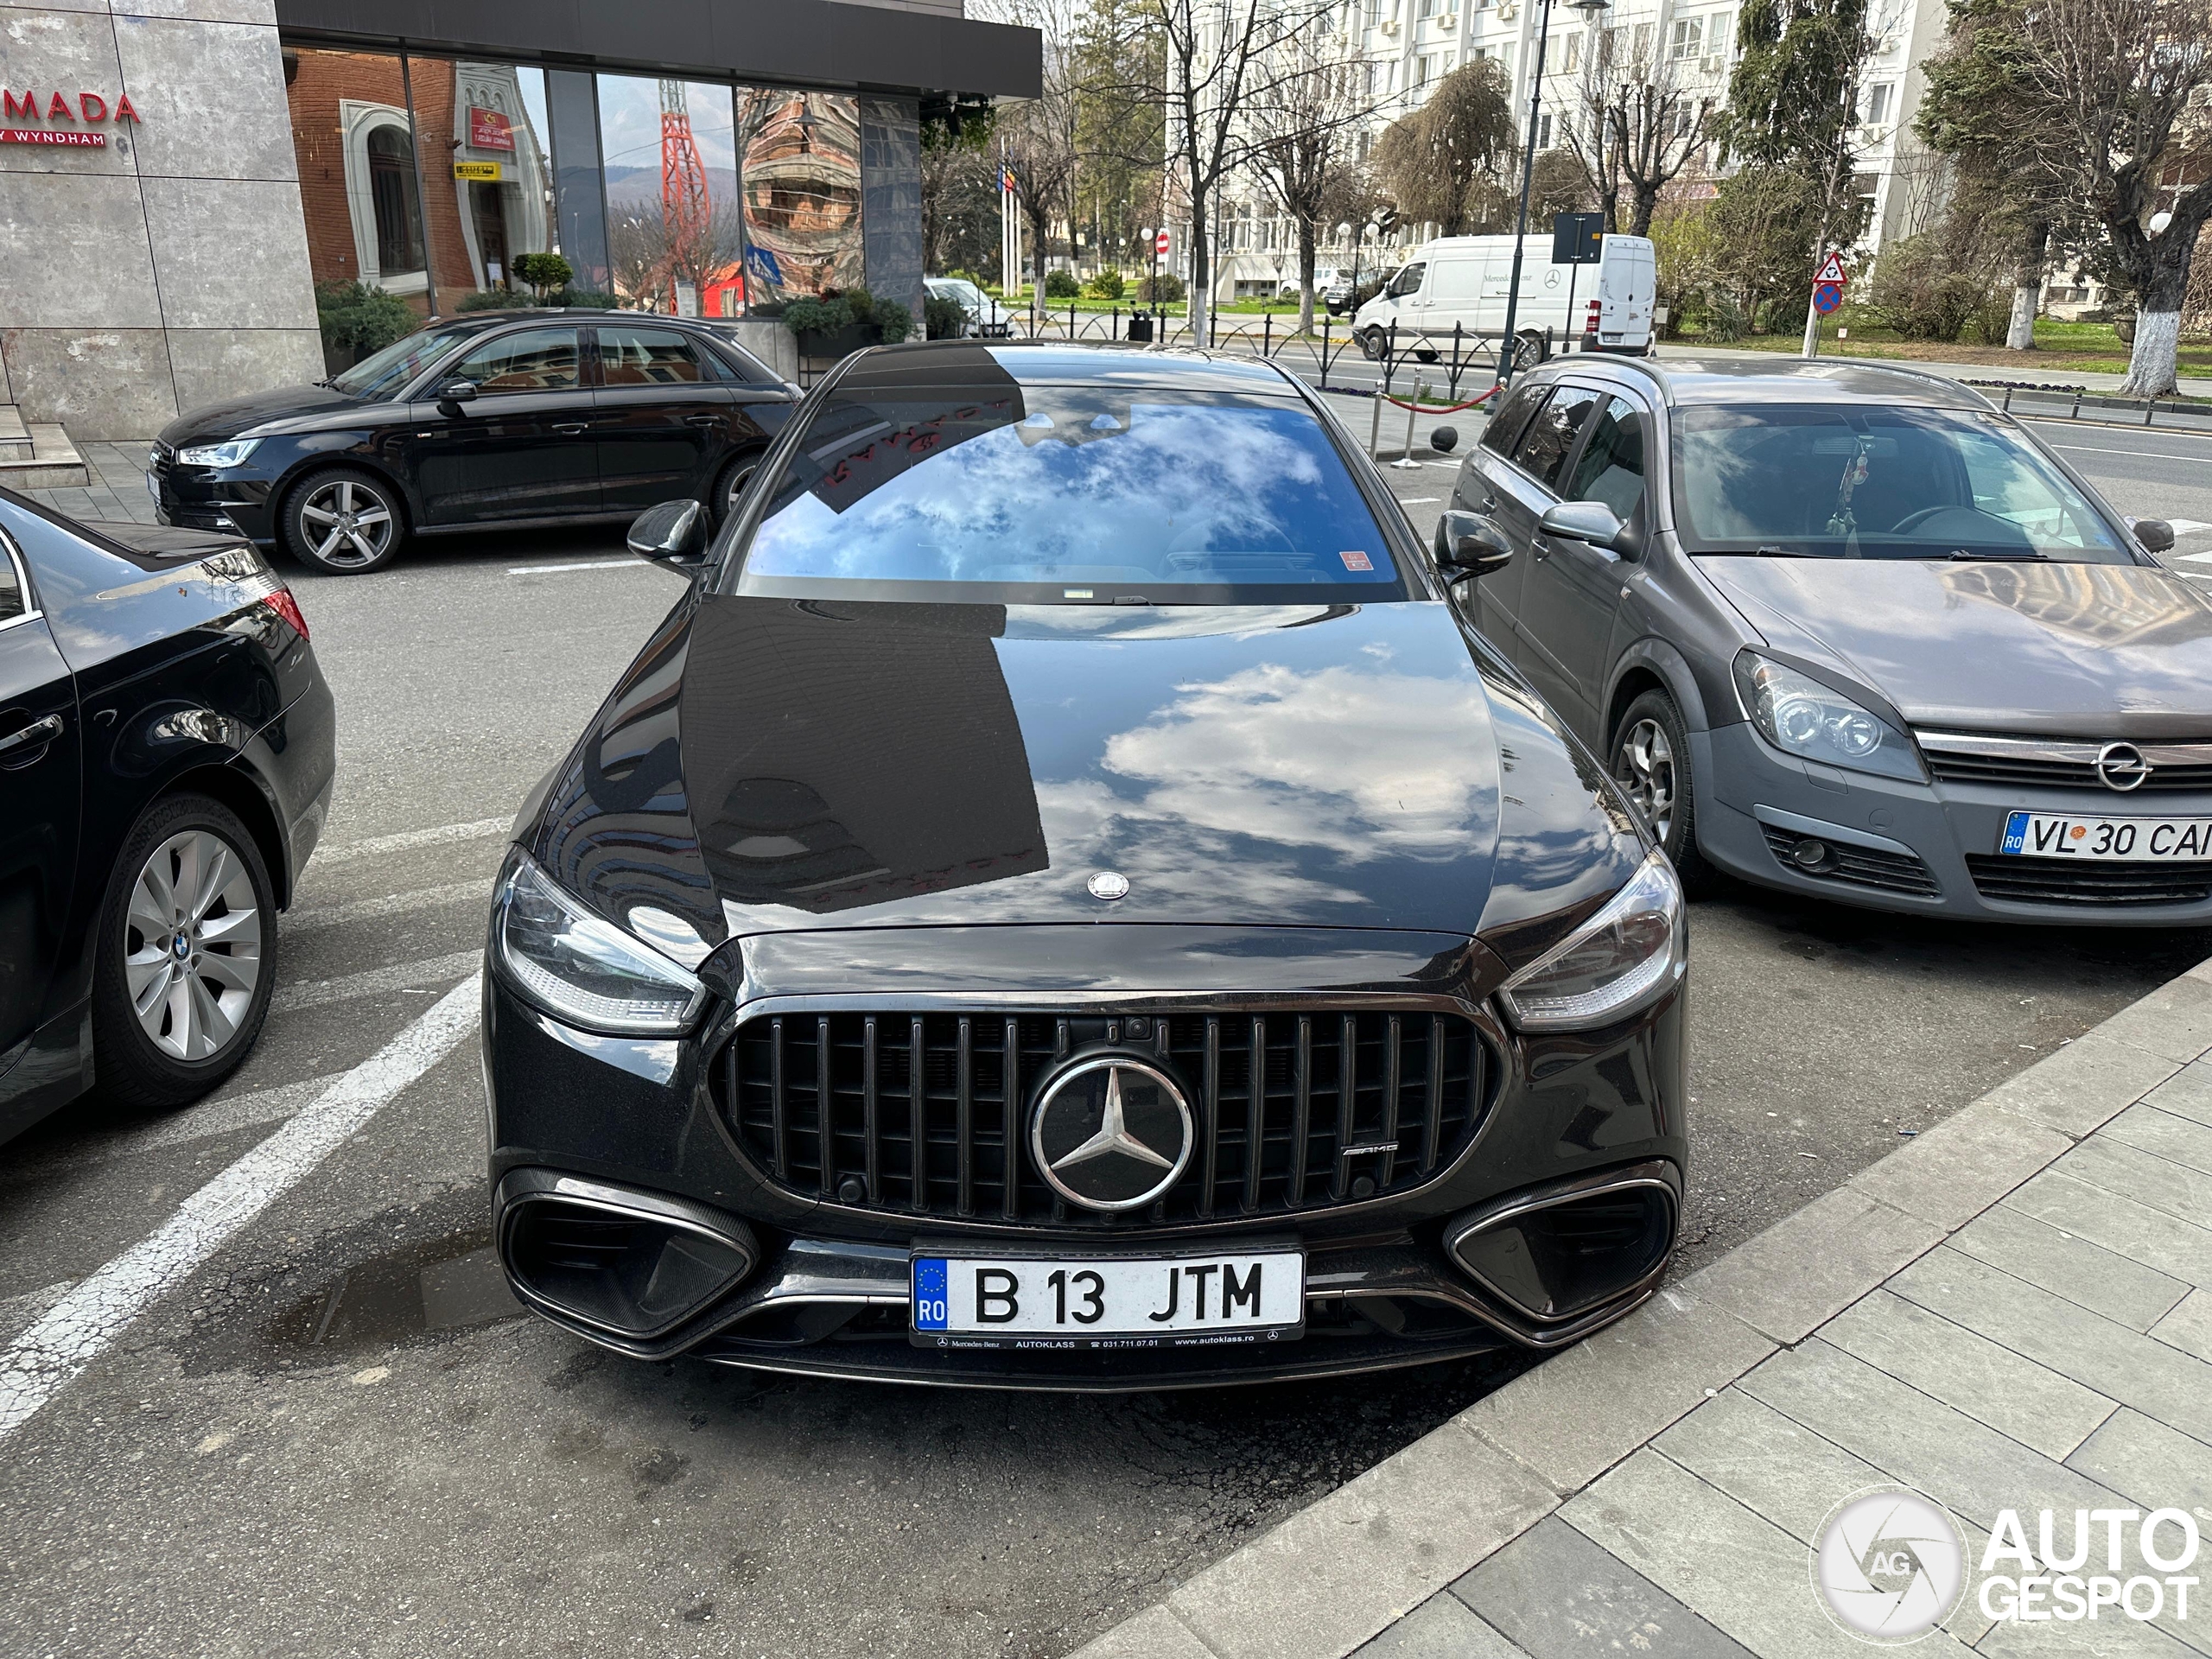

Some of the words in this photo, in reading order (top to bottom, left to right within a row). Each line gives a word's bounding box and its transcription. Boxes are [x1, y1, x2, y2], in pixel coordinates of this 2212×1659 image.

[3, 89, 141, 124] MADA
[14, 131, 105, 145] WYNDHAM
[2005, 836, 2022, 849] RO
[2034, 819, 2076, 854] VL
[2091, 823, 2137, 855] 30
[976, 1268, 1019, 1323] B
[1047, 1269, 1105, 1324] 13
[1147, 1262, 1262, 1322] JTM
[918, 1300, 945, 1322] RO
[951, 1340, 1000, 1349] Mercedes-Benz
[1015, 1340, 1075, 1349] AUTOKLASS
[1103, 1339, 1159, 1349] 031.711.07.01
[1174, 1334, 1255, 1347] www.autoklass.ro
